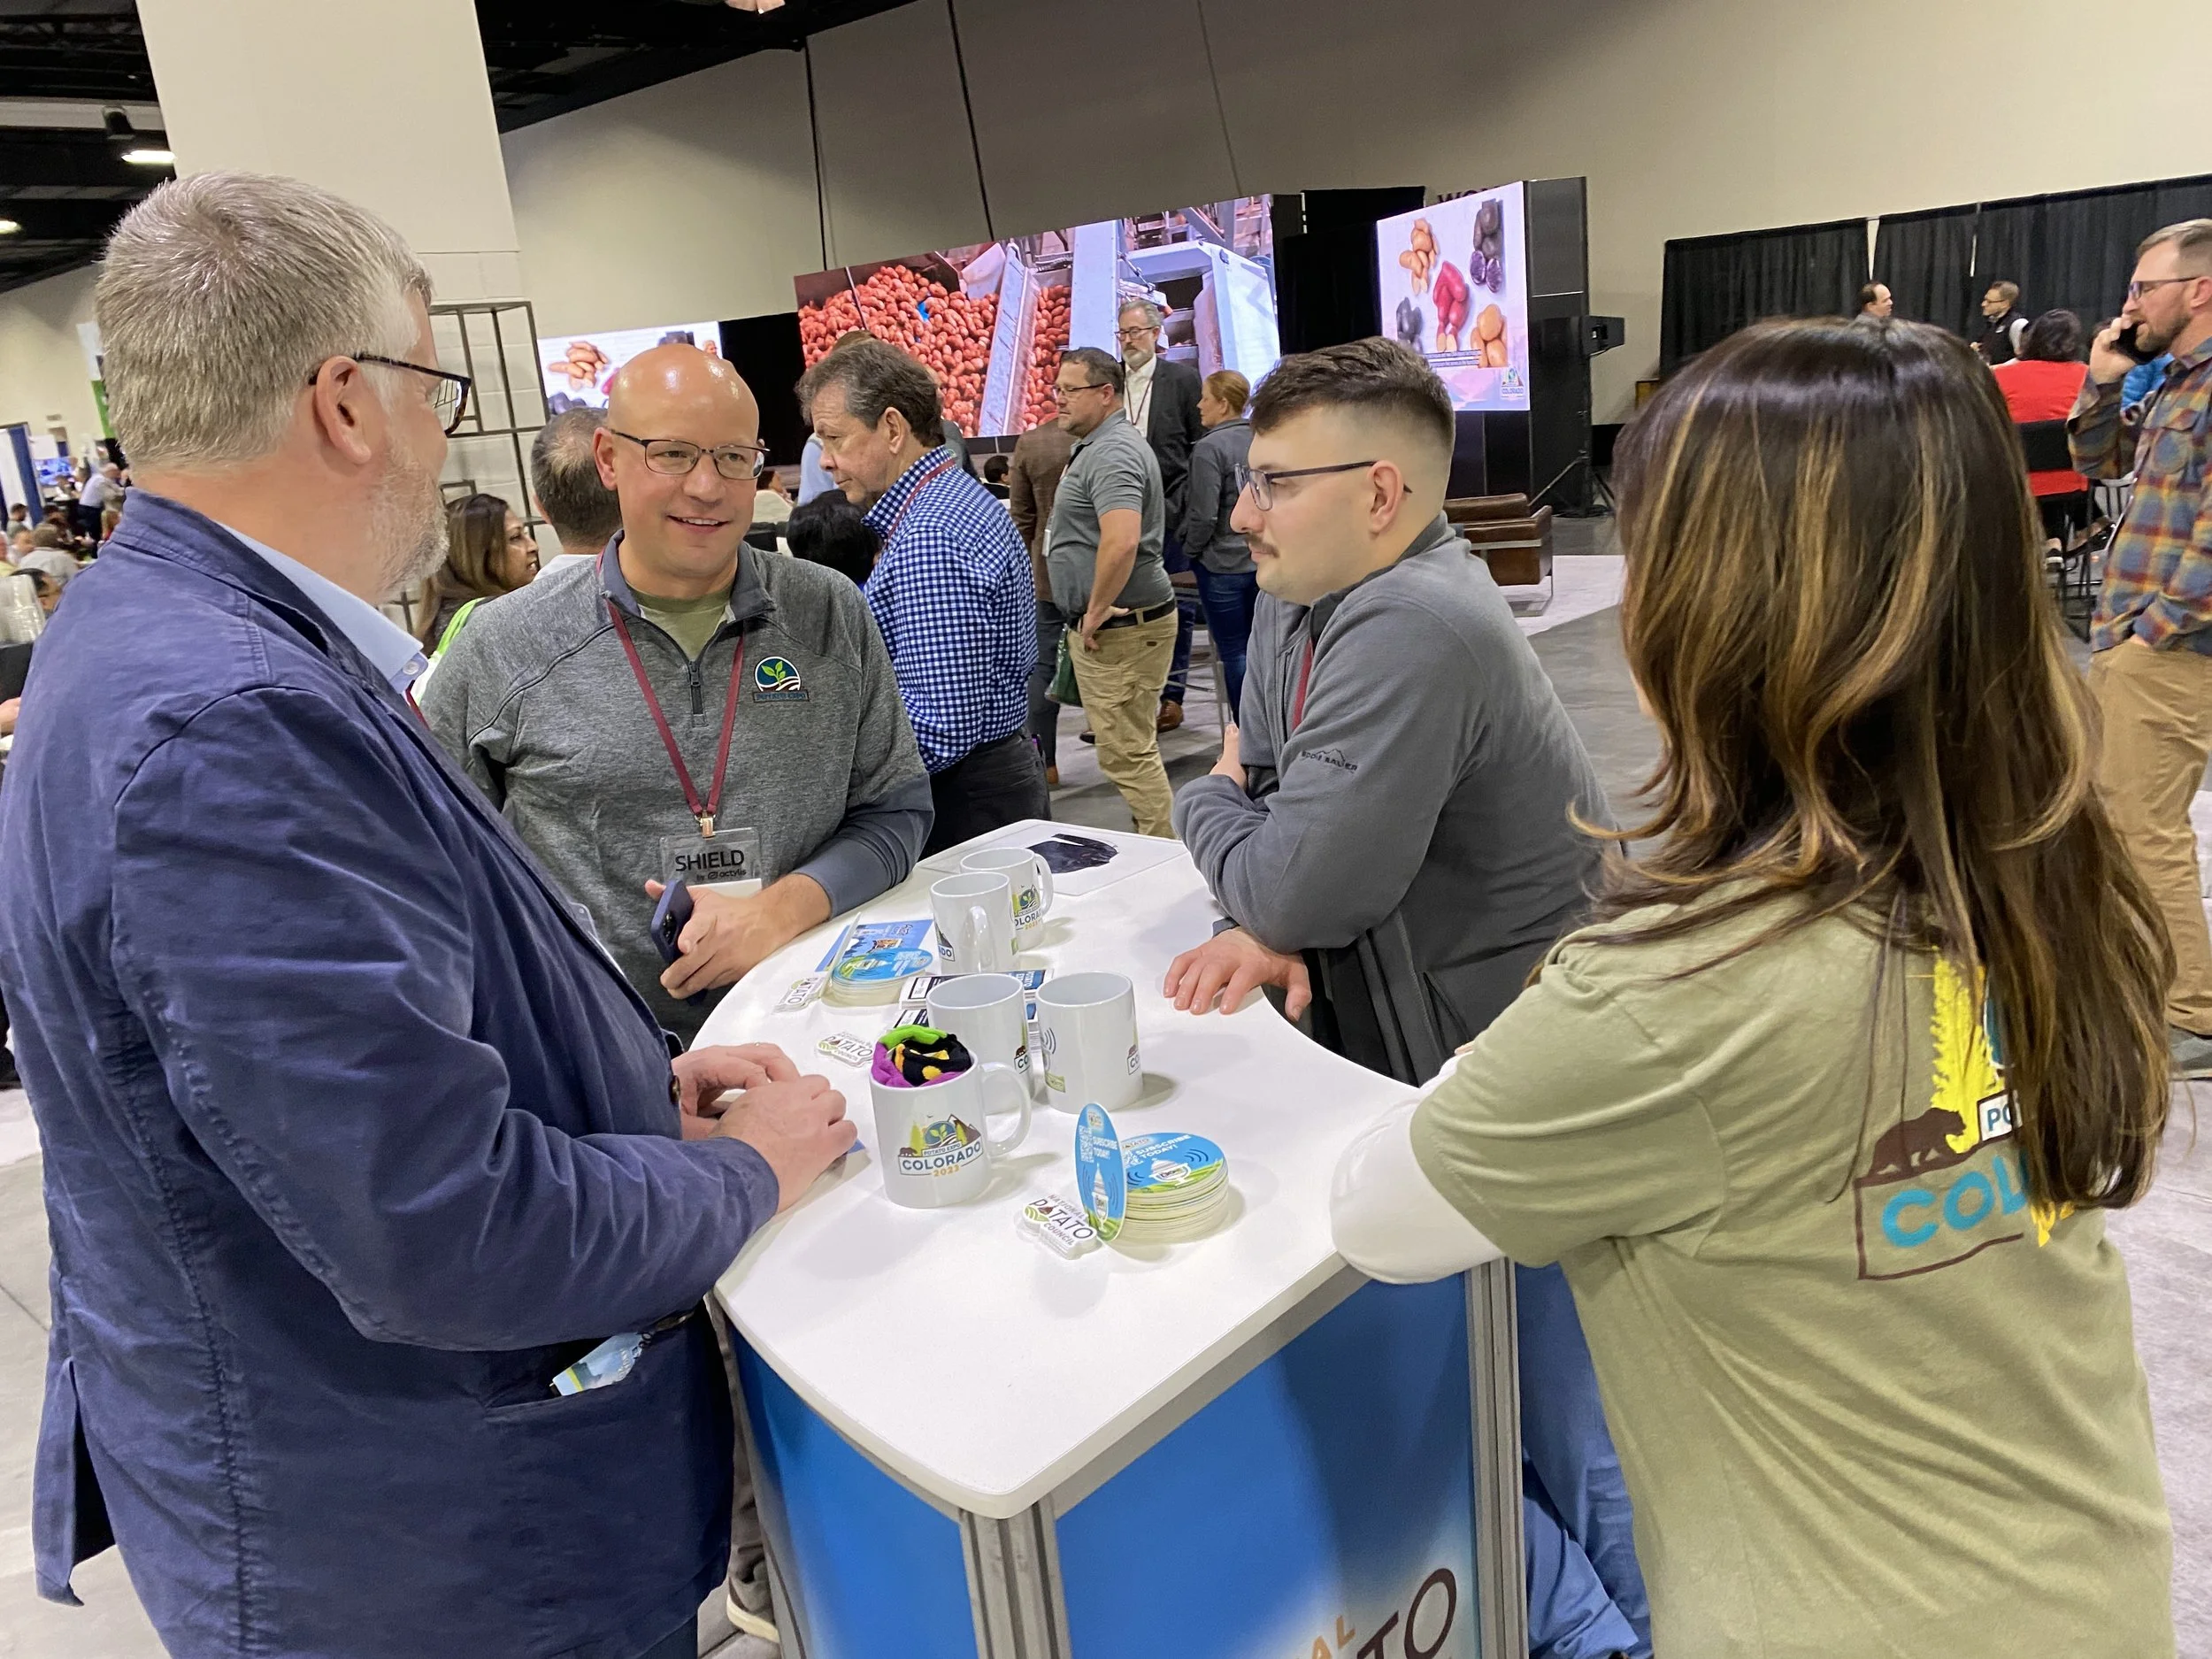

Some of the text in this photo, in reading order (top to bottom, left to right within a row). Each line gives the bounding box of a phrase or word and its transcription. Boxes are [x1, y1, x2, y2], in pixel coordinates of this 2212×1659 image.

[674, 849, 745, 872] SHIELD
[902, 1141, 981, 1171] COLORADO
[923, 1142, 961, 1156] POTATO EXPO
[1135, 1134, 1192, 1156] SUBSCRIBE
[1141, 1144, 1179, 1159] TODAY!
[933, 1164, 961, 1177] 2023
[1048, 1194, 1086, 1219] NATIONAL
[1044, 1223, 1075, 1246] COUNCIL
